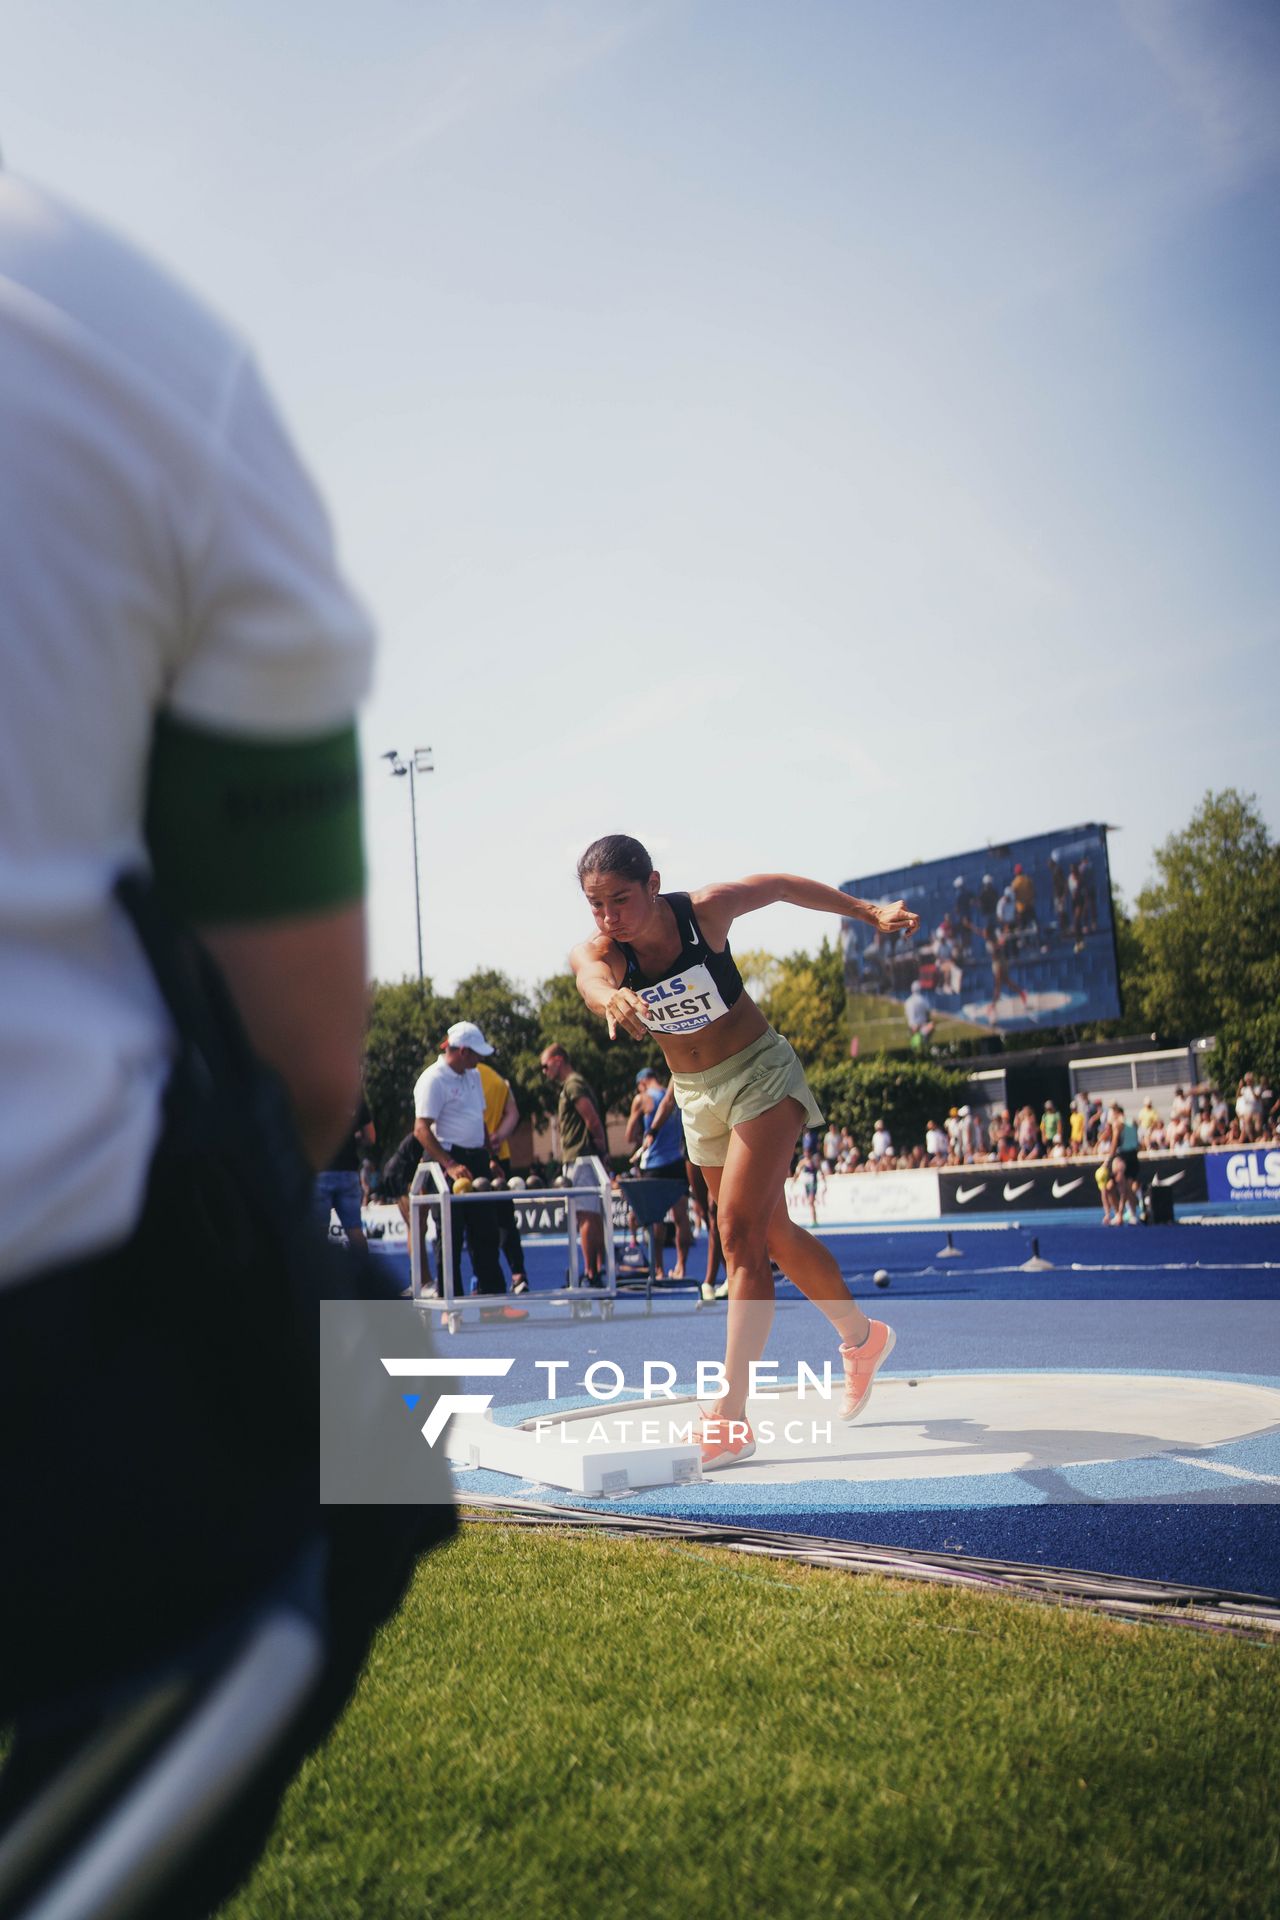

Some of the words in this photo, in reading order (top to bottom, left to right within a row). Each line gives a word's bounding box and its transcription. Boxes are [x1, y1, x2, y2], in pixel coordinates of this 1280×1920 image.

[641, 978, 686, 1004] GLS
[648, 992, 712, 1022] WEST
[680, 1016, 708, 1028] PLAN
[1226, 1151, 1280, 1189] GLS
